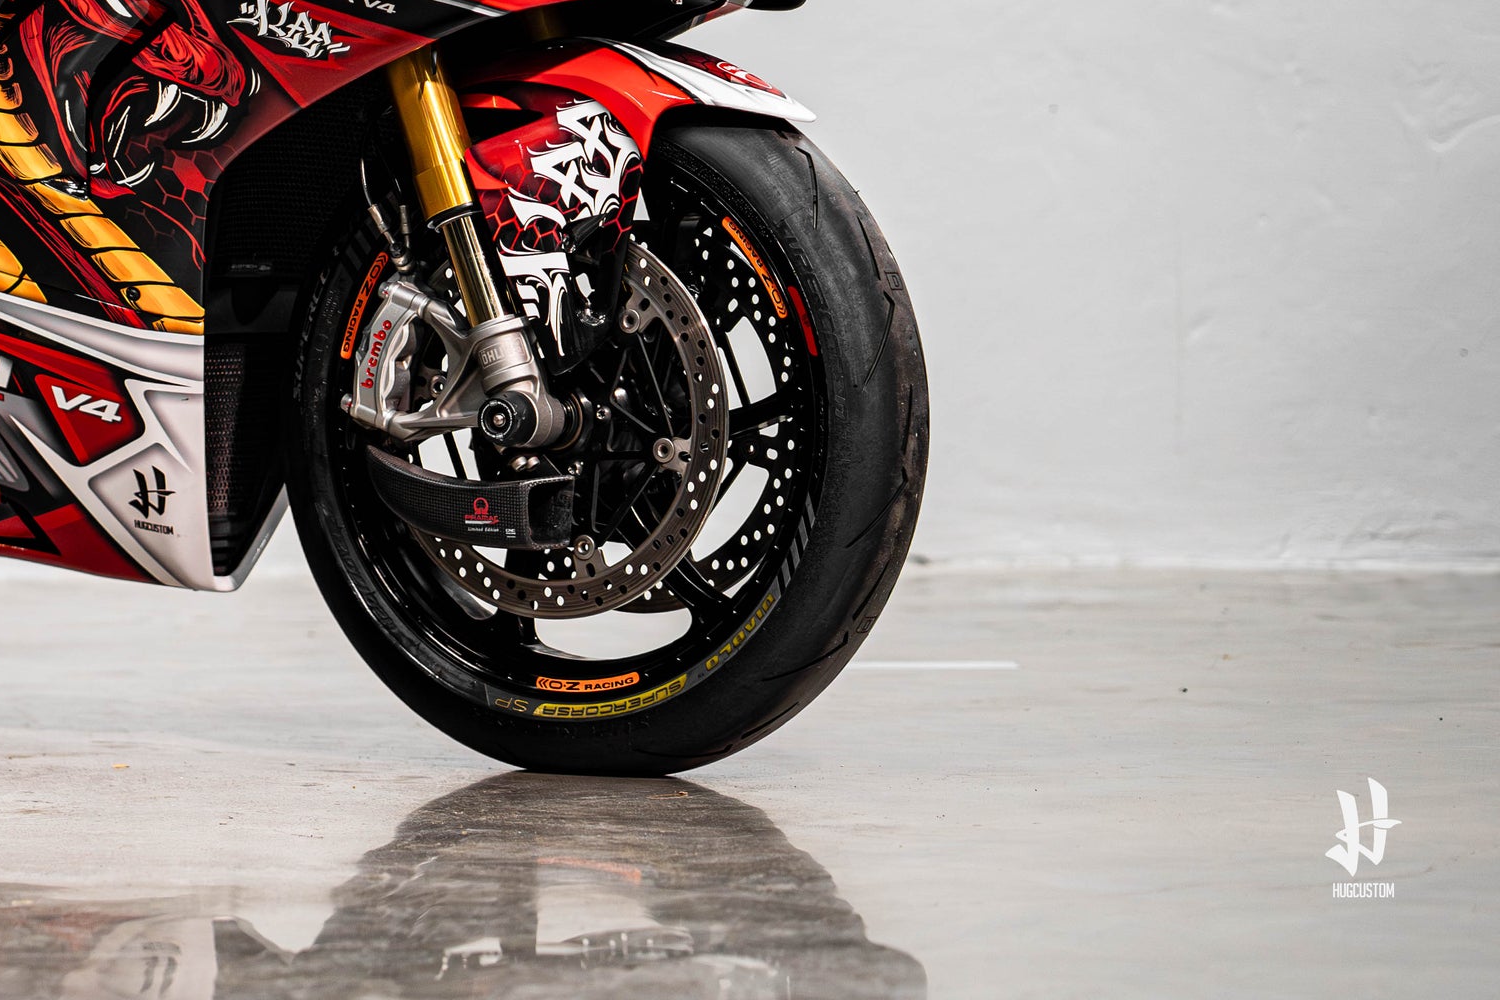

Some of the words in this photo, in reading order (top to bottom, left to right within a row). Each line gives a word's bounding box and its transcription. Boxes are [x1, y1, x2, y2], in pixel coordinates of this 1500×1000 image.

[360, 319, 393, 390] brembo
[51, 385, 123, 423] V4
[705, 594, 775, 672] DIABLO
[542, 680, 683, 717] SUPERCORSA
[584, 676, 635, 691] RACING
[494, 696, 530, 712] SP
